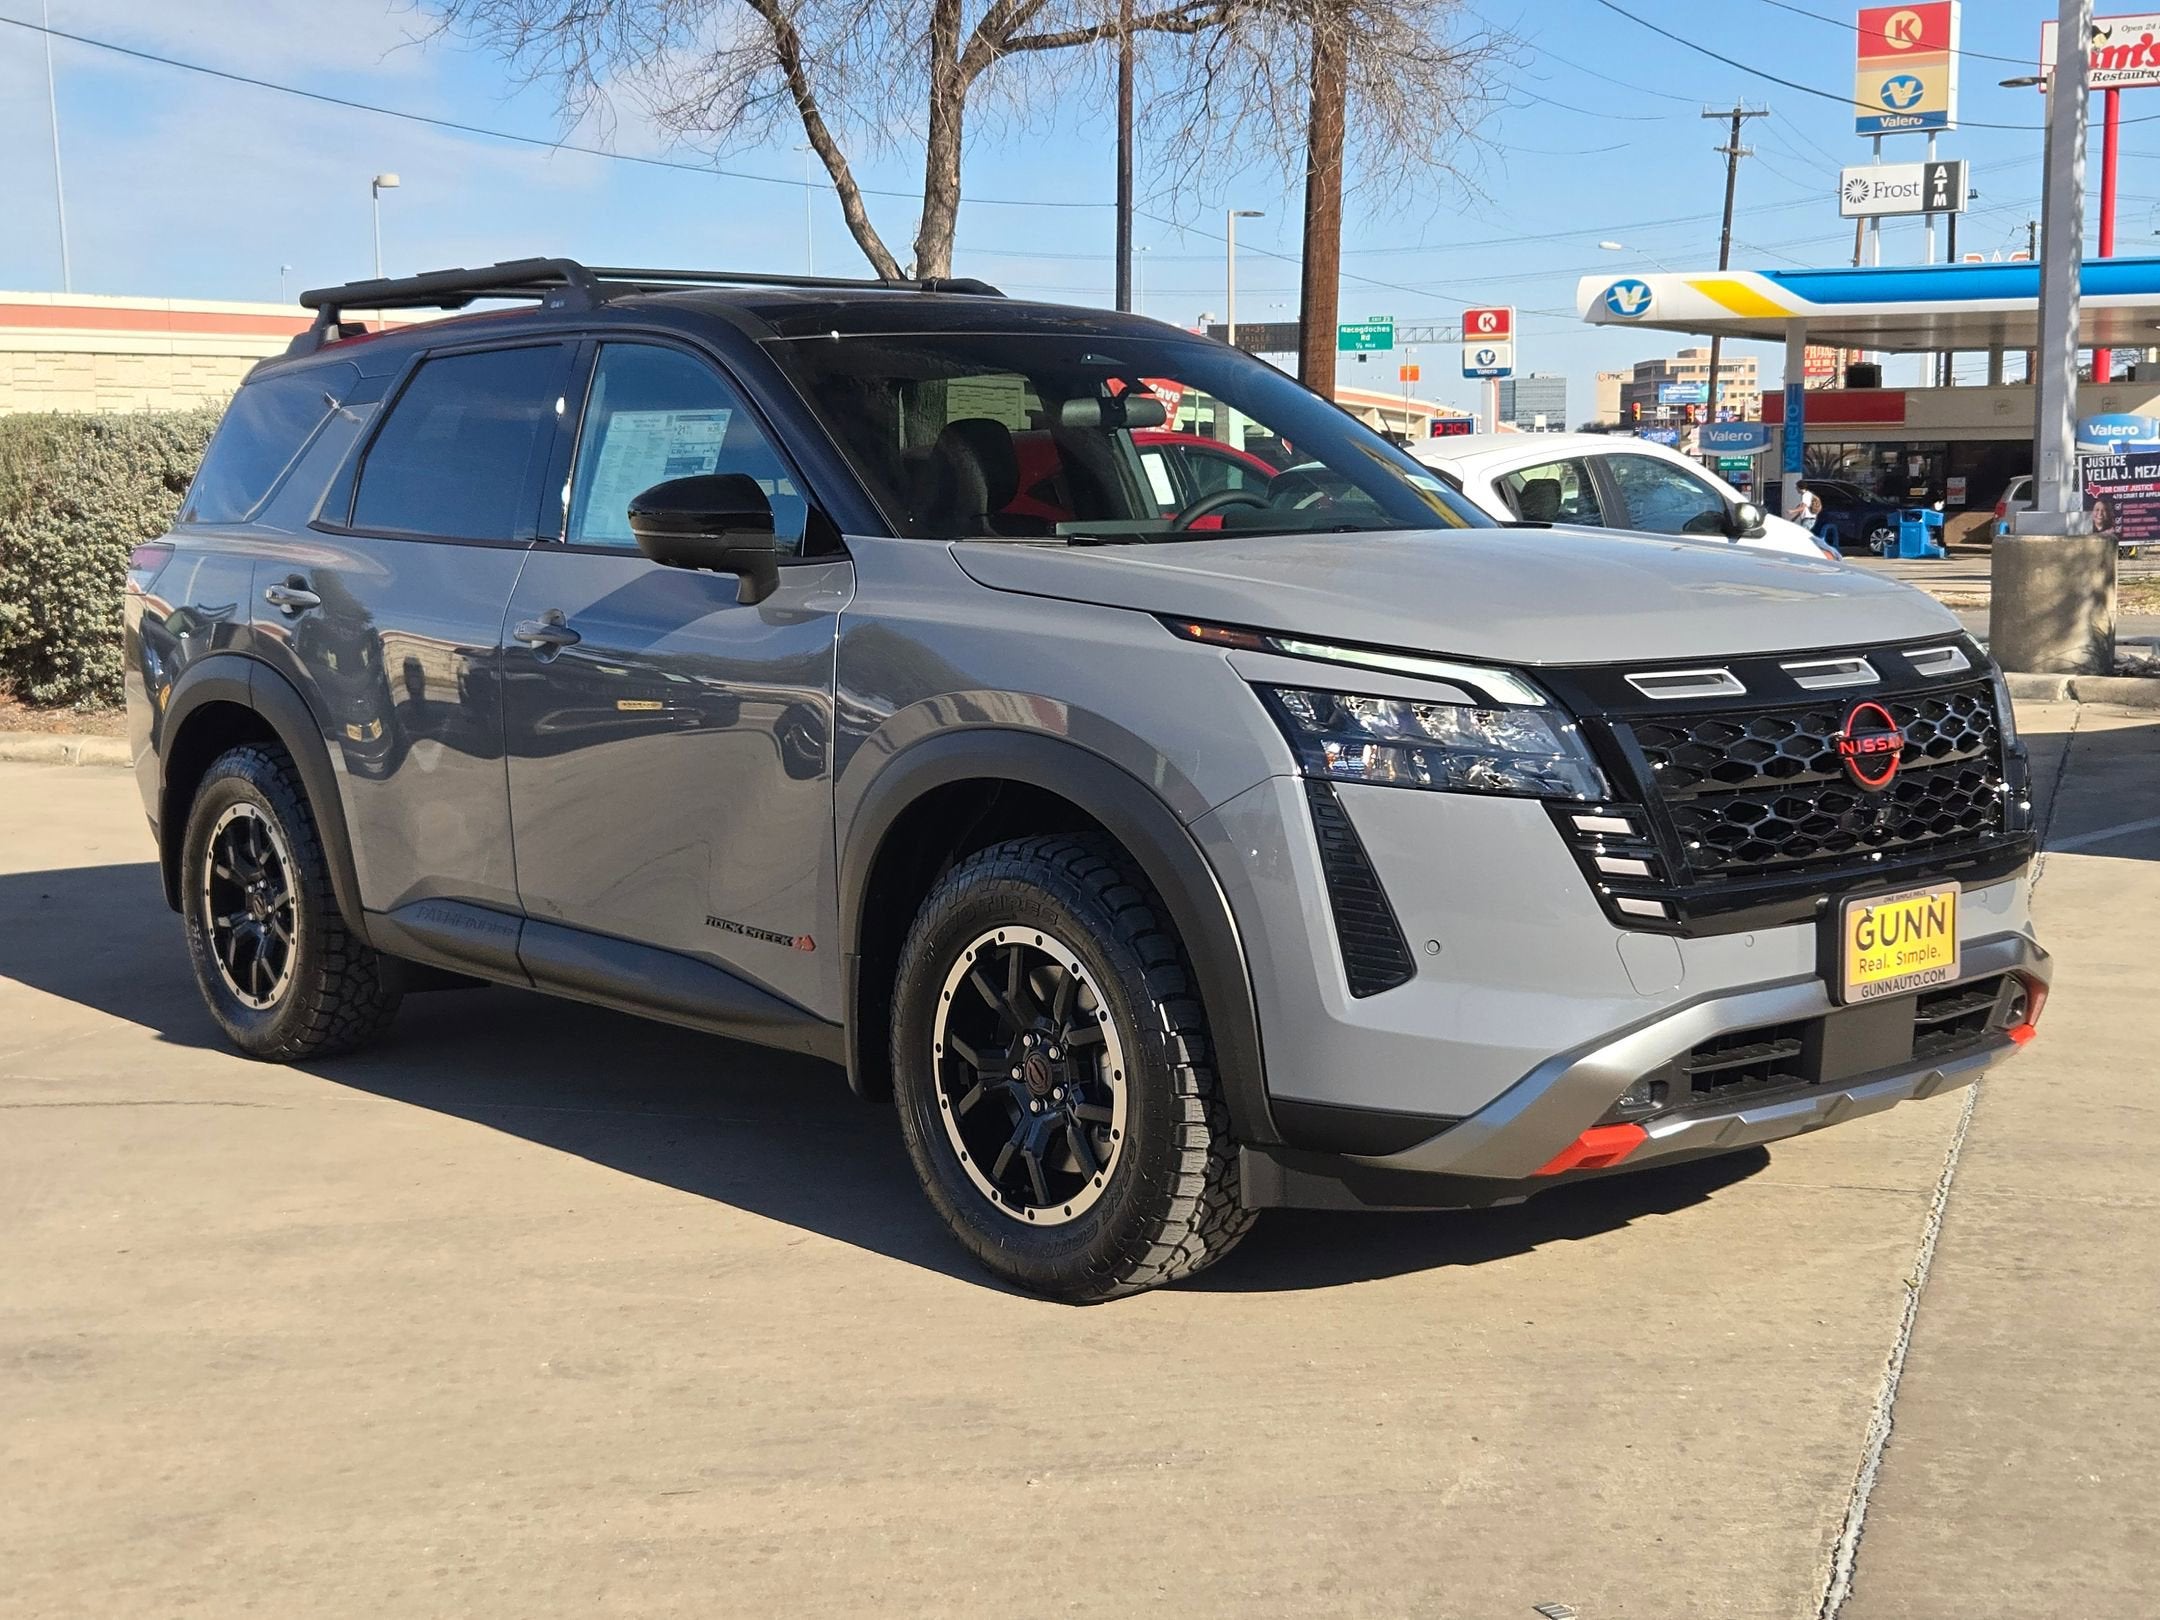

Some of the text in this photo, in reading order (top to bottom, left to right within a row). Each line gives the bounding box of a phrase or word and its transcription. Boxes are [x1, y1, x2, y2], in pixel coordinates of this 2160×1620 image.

[1895, 18, 1920, 44] K
[2121, 24, 2143, 34] Open
[2145, 23, 2157, 31] 24
[2091, 33, 2160, 69] im's
[2092, 69, 2160, 82] Restaura
[1880, 115, 1923, 127] Valero
[1872, 181, 1920, 199] Frost
[1932, 165, 1948, 207] ATM
[1341, 325, 1390, 334] Nacogdoches
[1361, 333, 1371, 341] Rd
[1709, 431, 1753, 442] Valero
[2088, 424, 2140, 436] Valero
[2086, 455, 2127, 468] JUSTICE
[2086, 467, 2119, 482] VELIA
[2121, 466, 2132, 480] J.
[2102, 483, 2154, 494] FOR CHIEF JUSTICE
[1840, 735, 1904, 755] NISSAN
[704, 915, 794, 947] ROCK CREEK
[1856, 902, 1945, 951] GUNN
[1860, 944, 1941, 975] Real. Simple.
[1861, 968, 1946, 998] GUNNAUTO.COM
